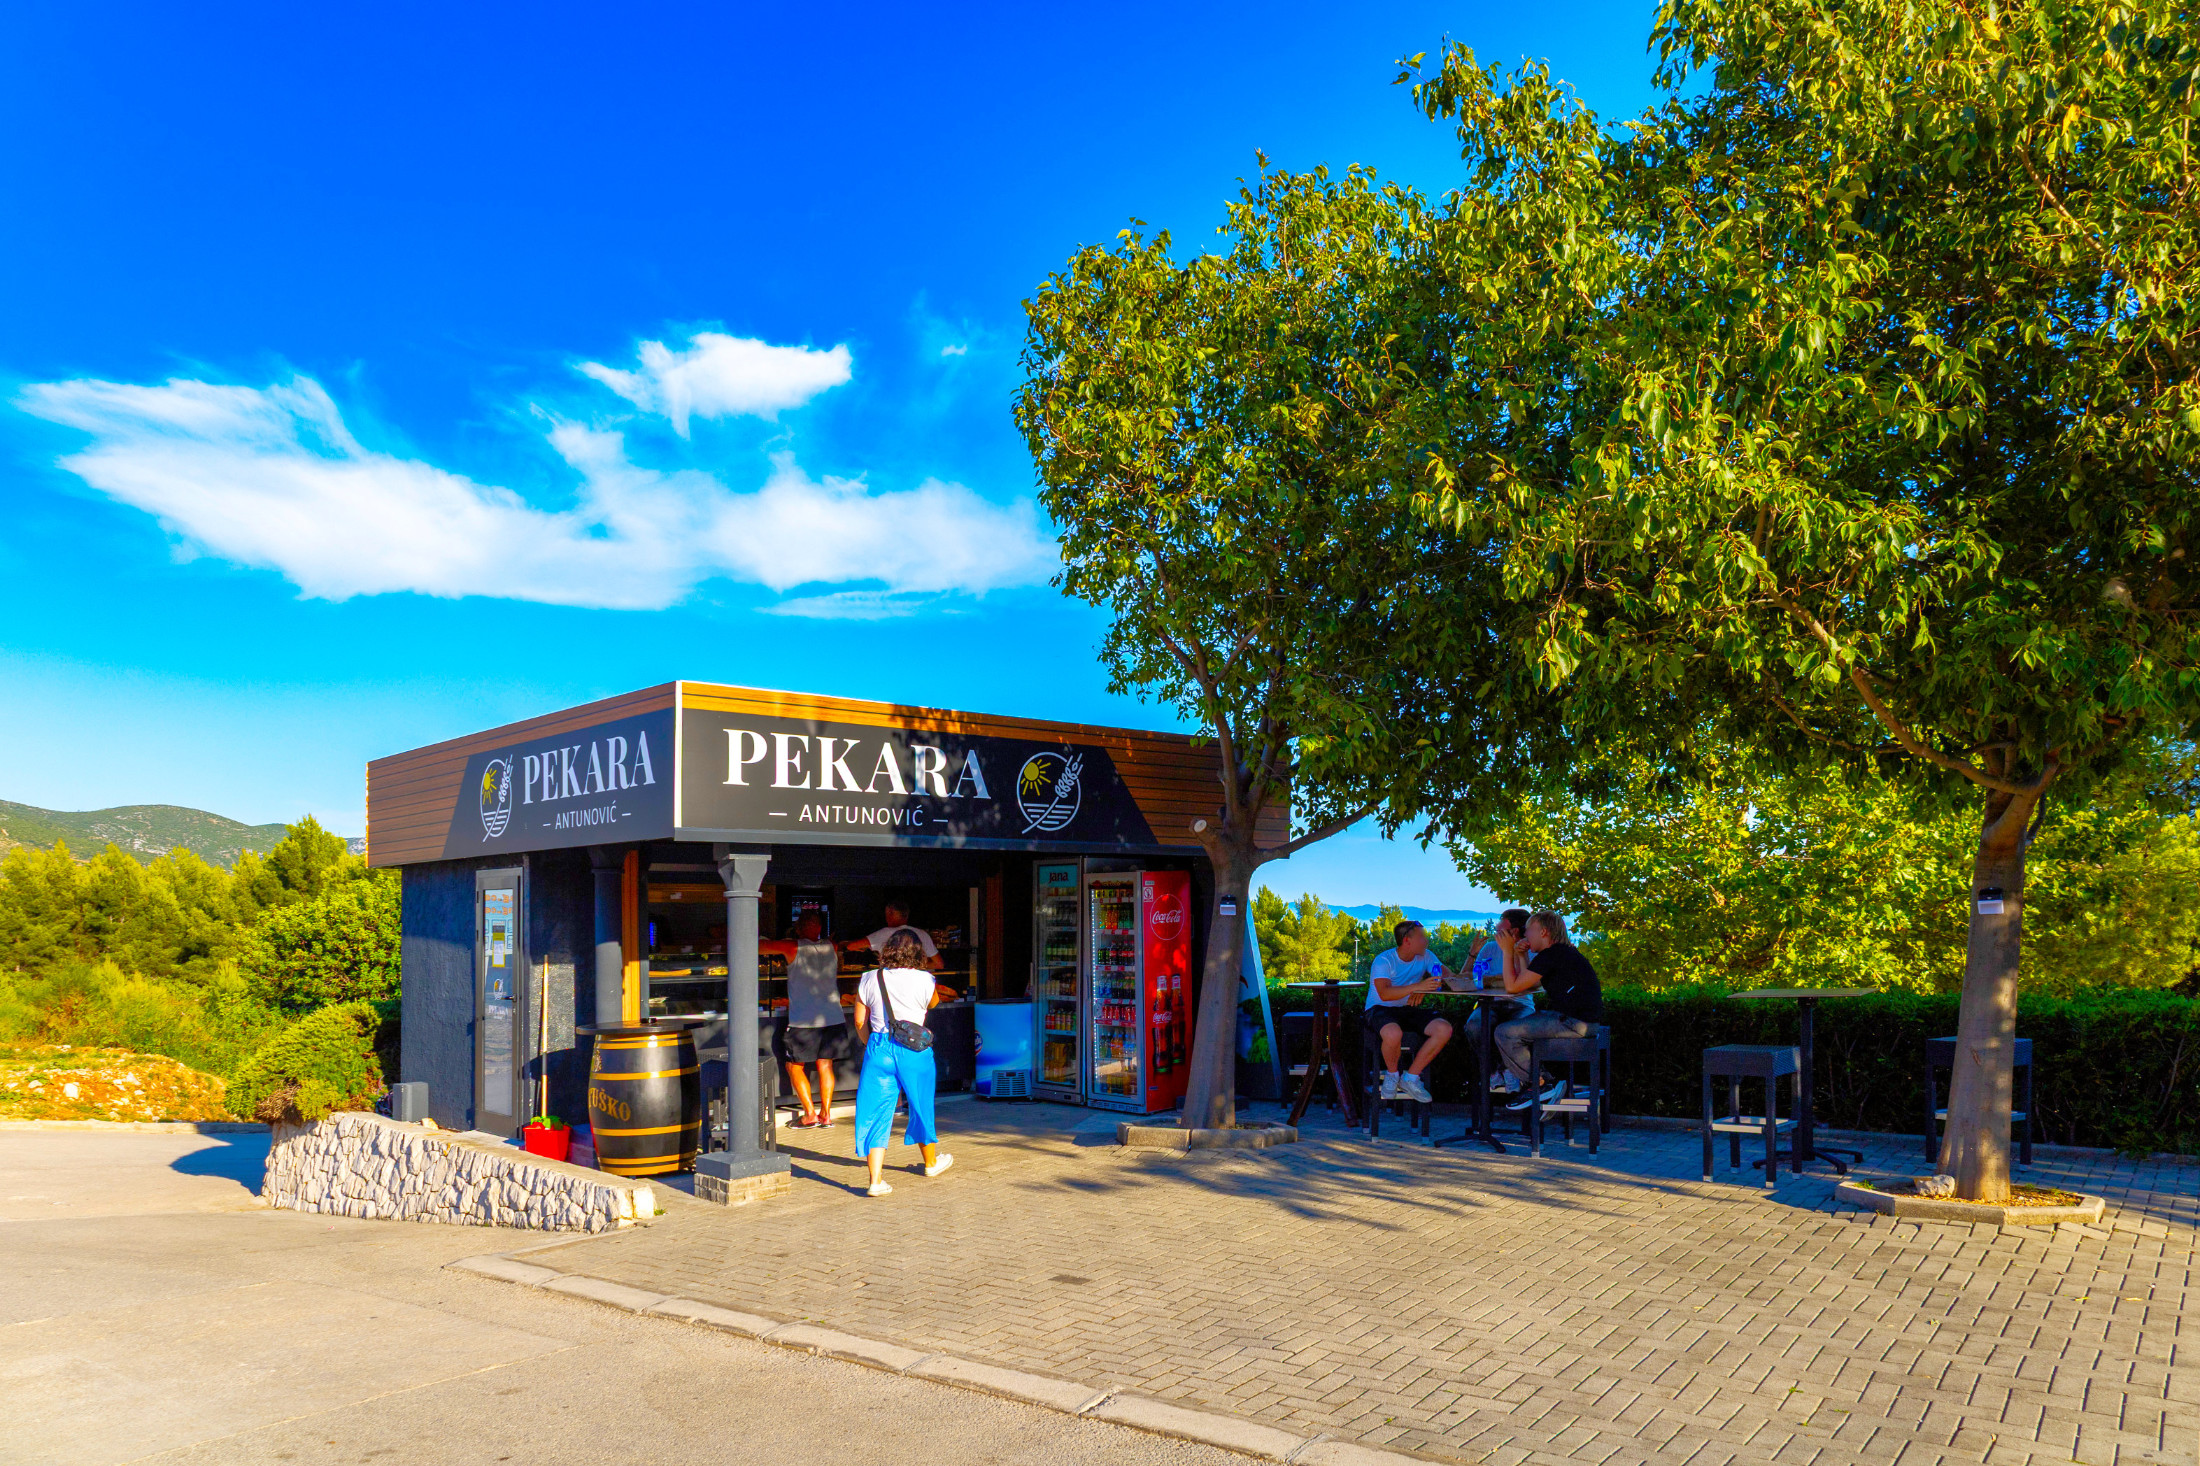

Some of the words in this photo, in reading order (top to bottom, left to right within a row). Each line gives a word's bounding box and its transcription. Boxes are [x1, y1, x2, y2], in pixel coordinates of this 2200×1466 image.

[522, 730, 656, 805] PEKARA
[722, 728, 992, 800] PEKARA
[554, 800, 617, 830] ANTUNOVIĆ
[798, 803, 924, 827] ANTUNOVIĆ
